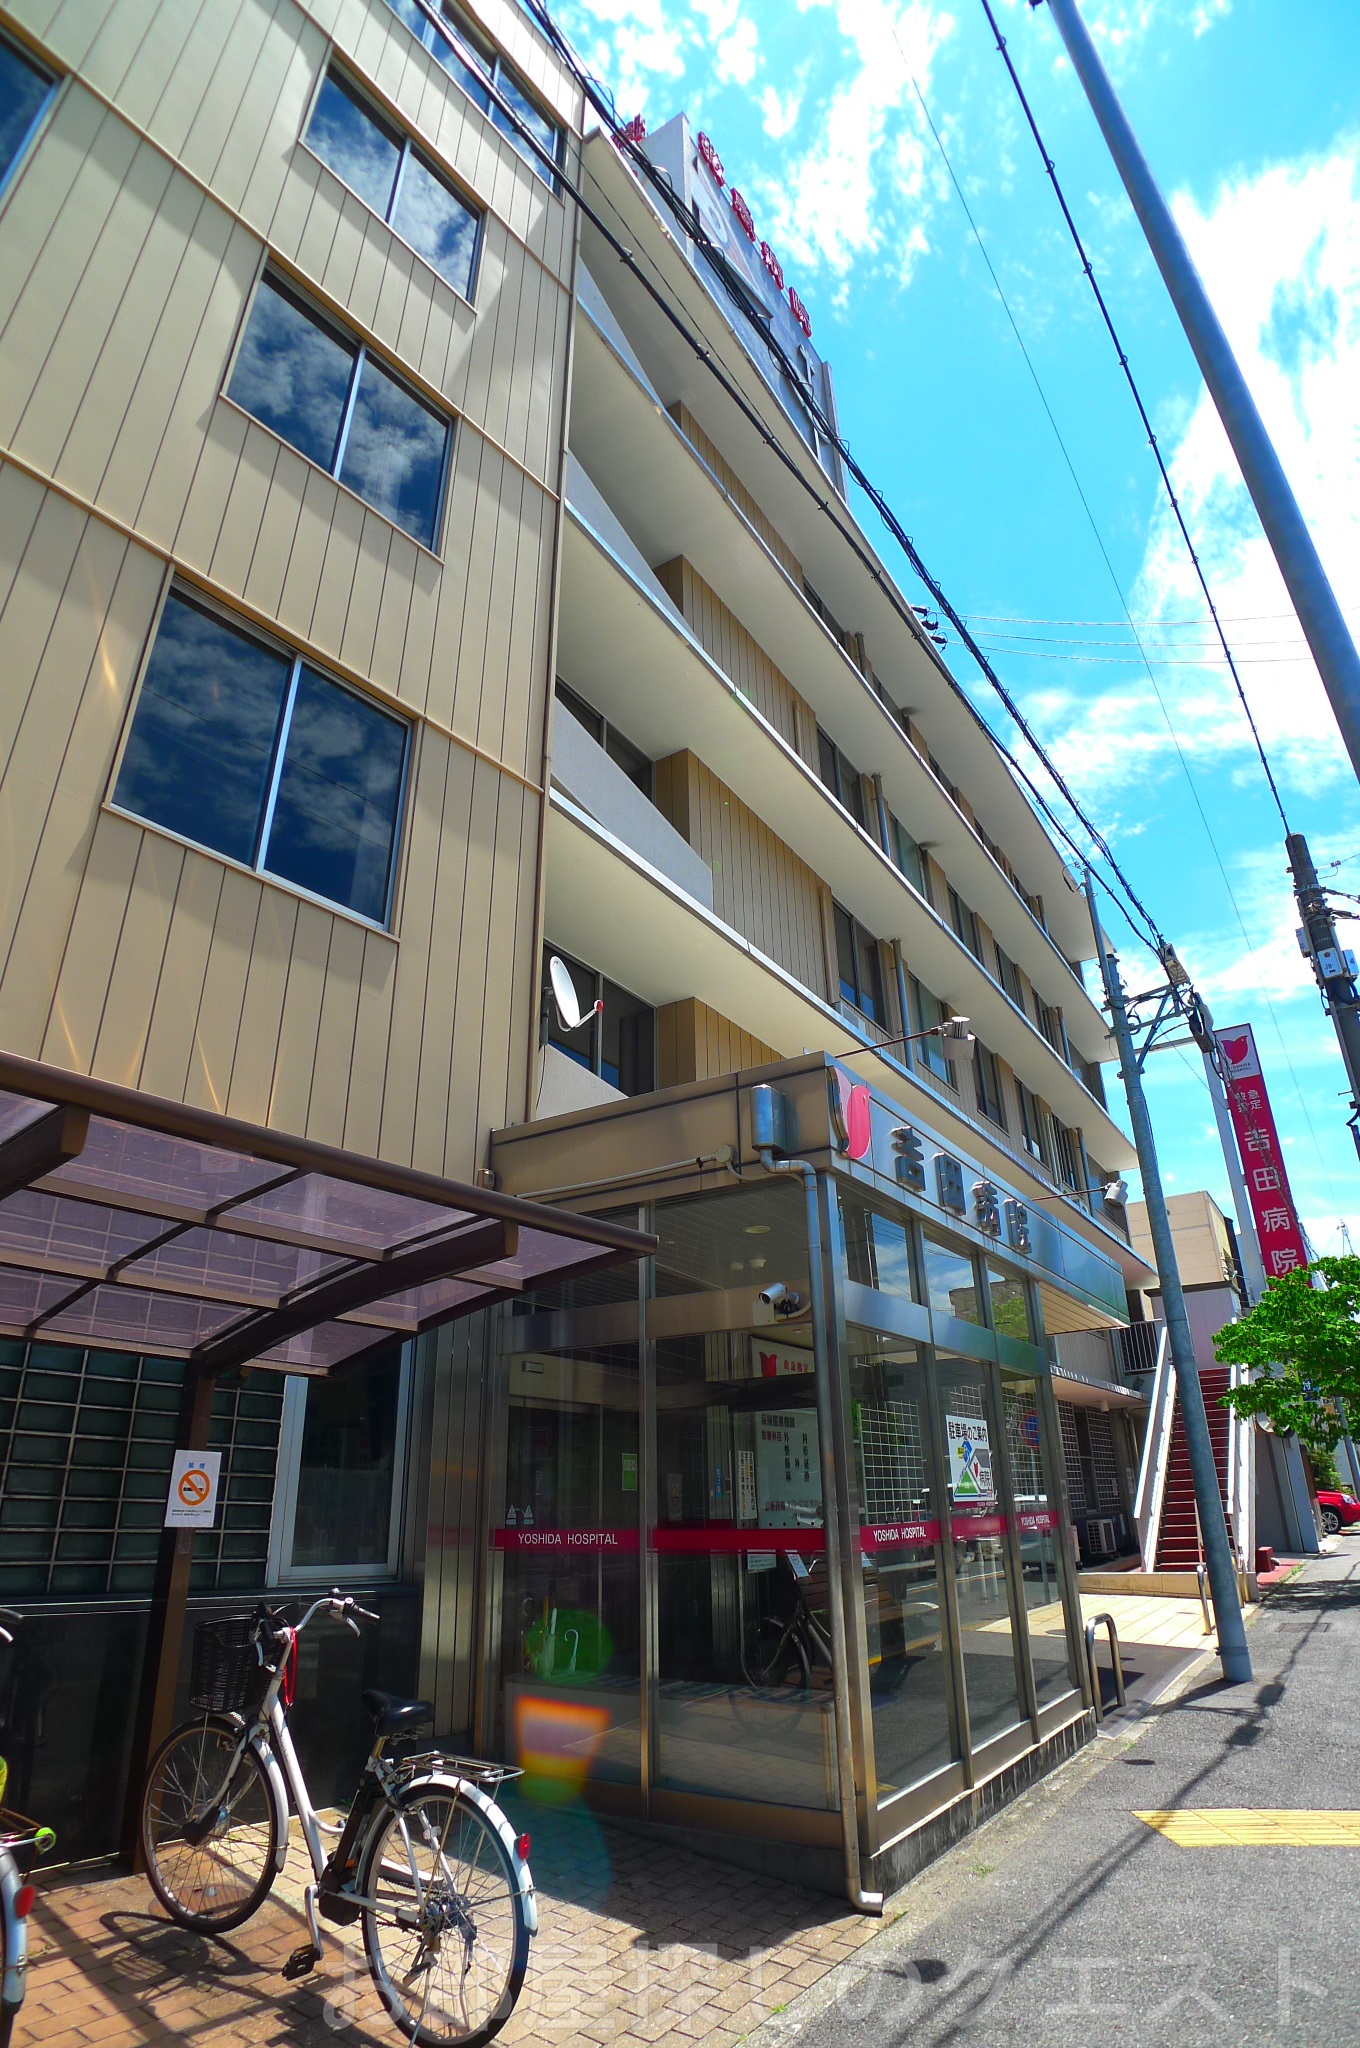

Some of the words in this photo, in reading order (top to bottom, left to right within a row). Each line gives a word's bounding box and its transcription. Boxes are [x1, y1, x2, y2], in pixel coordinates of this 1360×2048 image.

[891, 1125, 1032, 1254] 吉田病院
[1244, 1127, 1299, 1275] 吉田病院
[947, 1421, 988, 1442] 駐車場のご案内
[1020, 1516, 1035, 1526] YOSHIDA
[1035, 1514, 1050, 1524] HOSPITAL
[518, 1533, 562, 1545] YOSHIDA
[567, 1533, 618, 1545] HOSPITAL
[873, 1528, 900, 1542] YOSHIDA
[901, 1526, 927, 1540] HOSPITAL
